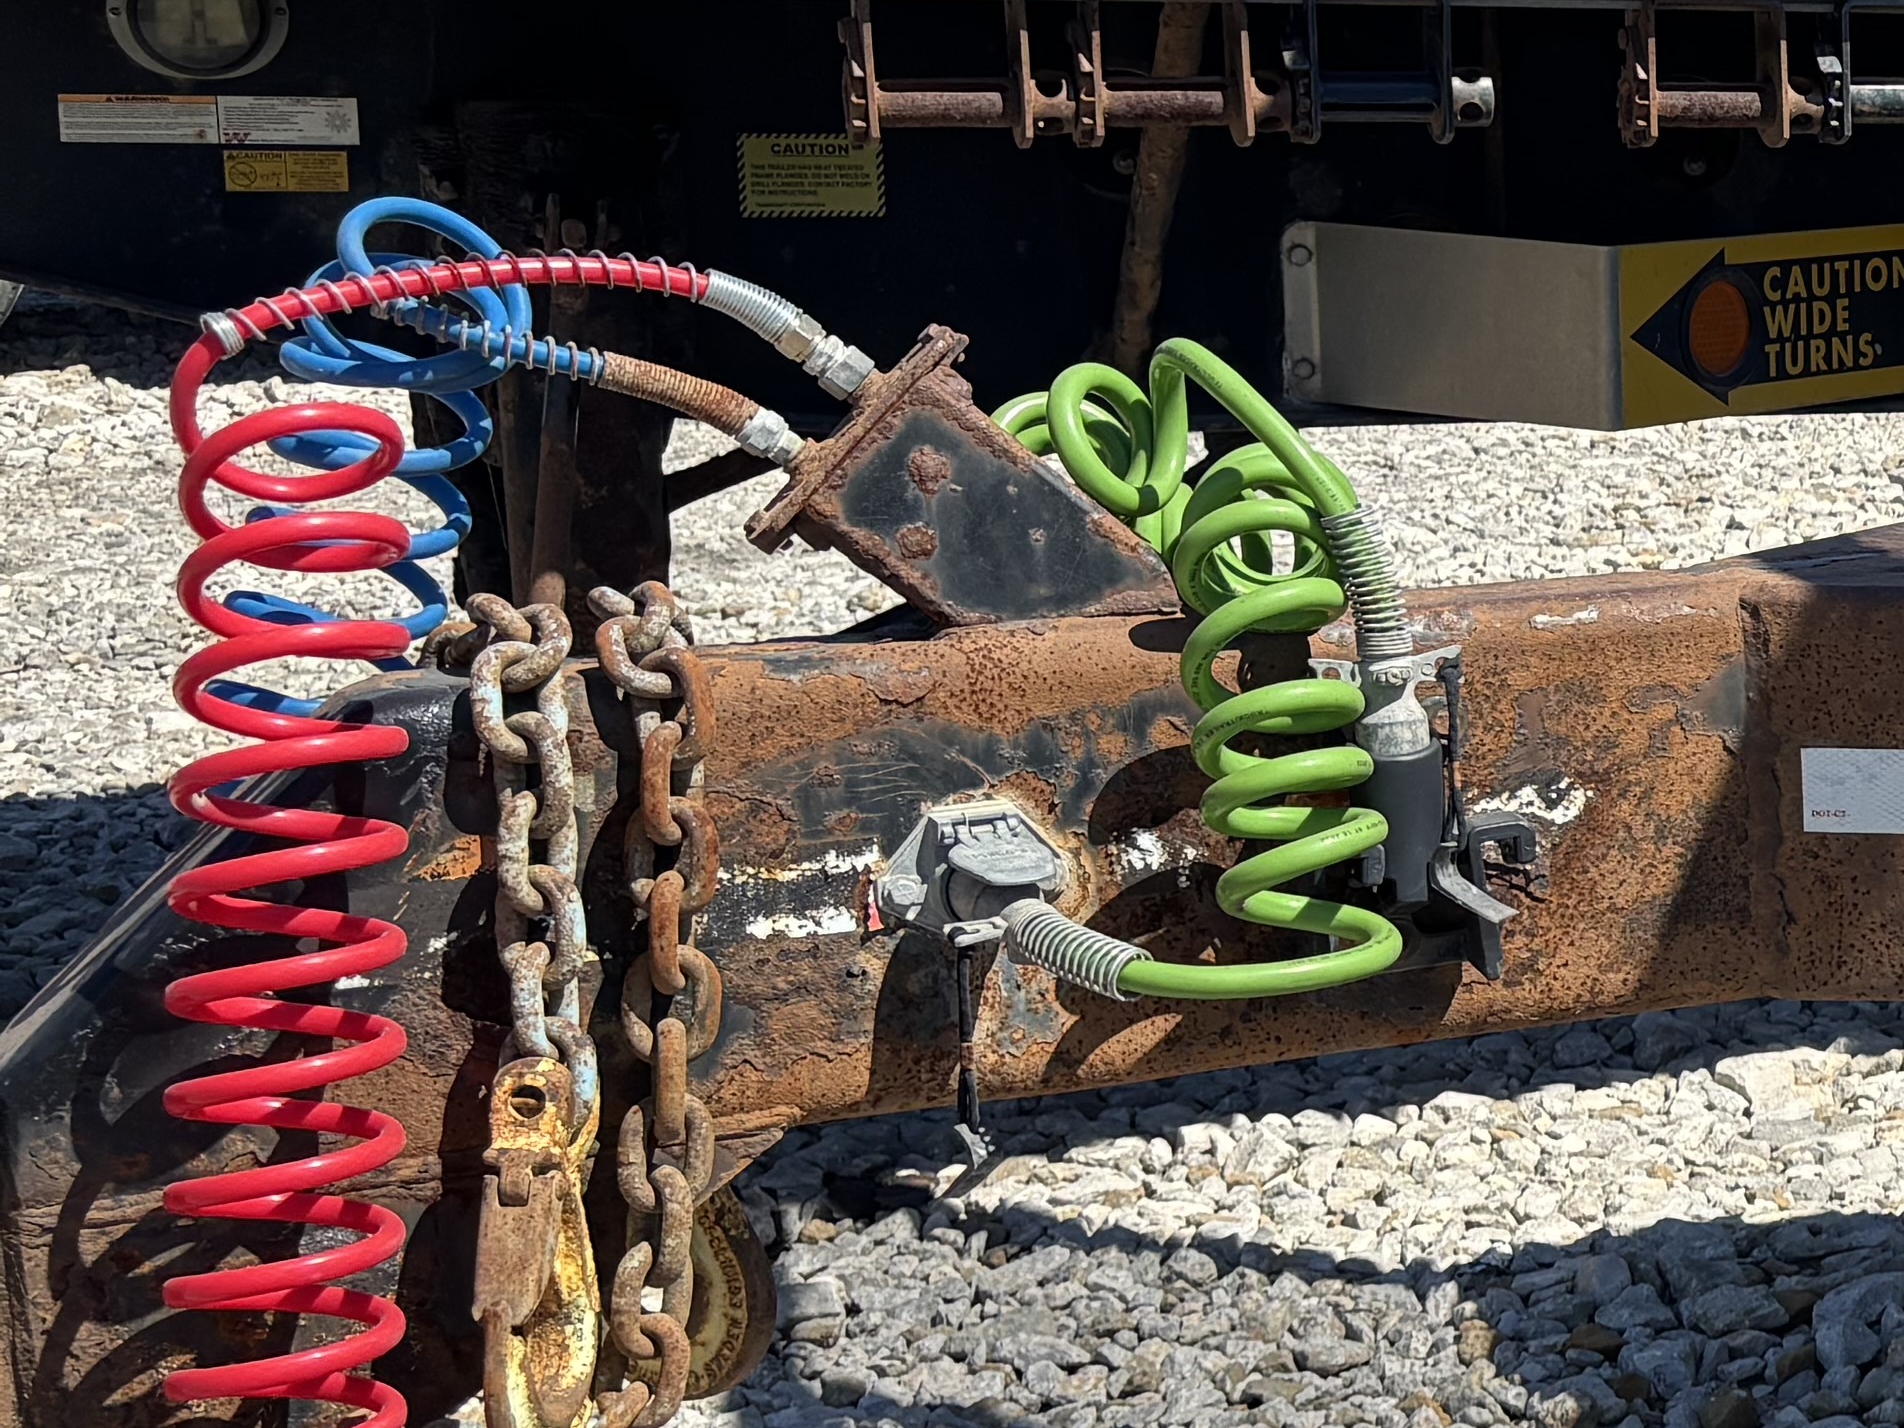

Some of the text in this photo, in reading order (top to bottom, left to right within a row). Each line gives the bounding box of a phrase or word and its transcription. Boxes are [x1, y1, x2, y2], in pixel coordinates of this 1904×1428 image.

[771, 143, 849, 155] CAUTION
[1763, 298, 1849, 339] WIDE
[1764, 332, 1875, 377] TURNS
